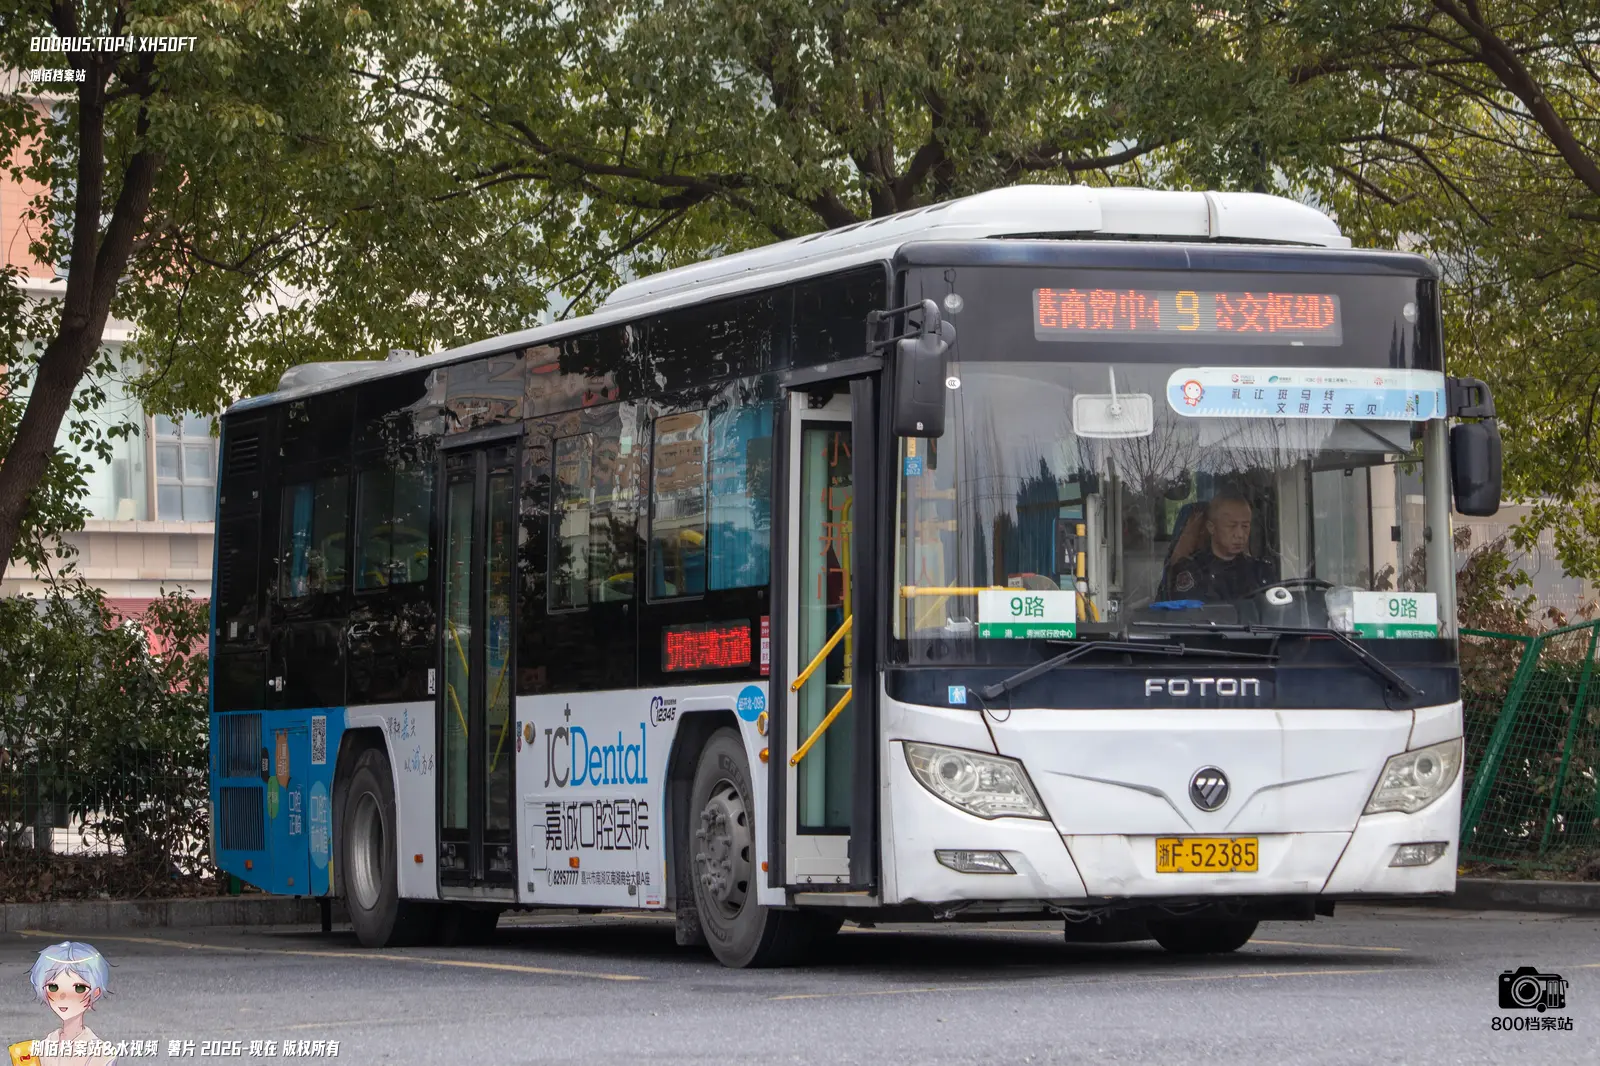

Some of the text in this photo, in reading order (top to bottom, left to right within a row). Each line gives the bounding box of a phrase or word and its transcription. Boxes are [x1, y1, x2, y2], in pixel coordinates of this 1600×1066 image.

[1176, 290, 1199, 330] 9
[1276, 402, 1377, 415] 文明天天见
[1010, 596, 1044, 617] 9路
[1389, 598, 1417, 618] 9路
[1145, 677, 1260, 697] FOTON
[656, 707, 676, 722] 12345
[544, 799, 649, 851] 嘉诚口腔医院
